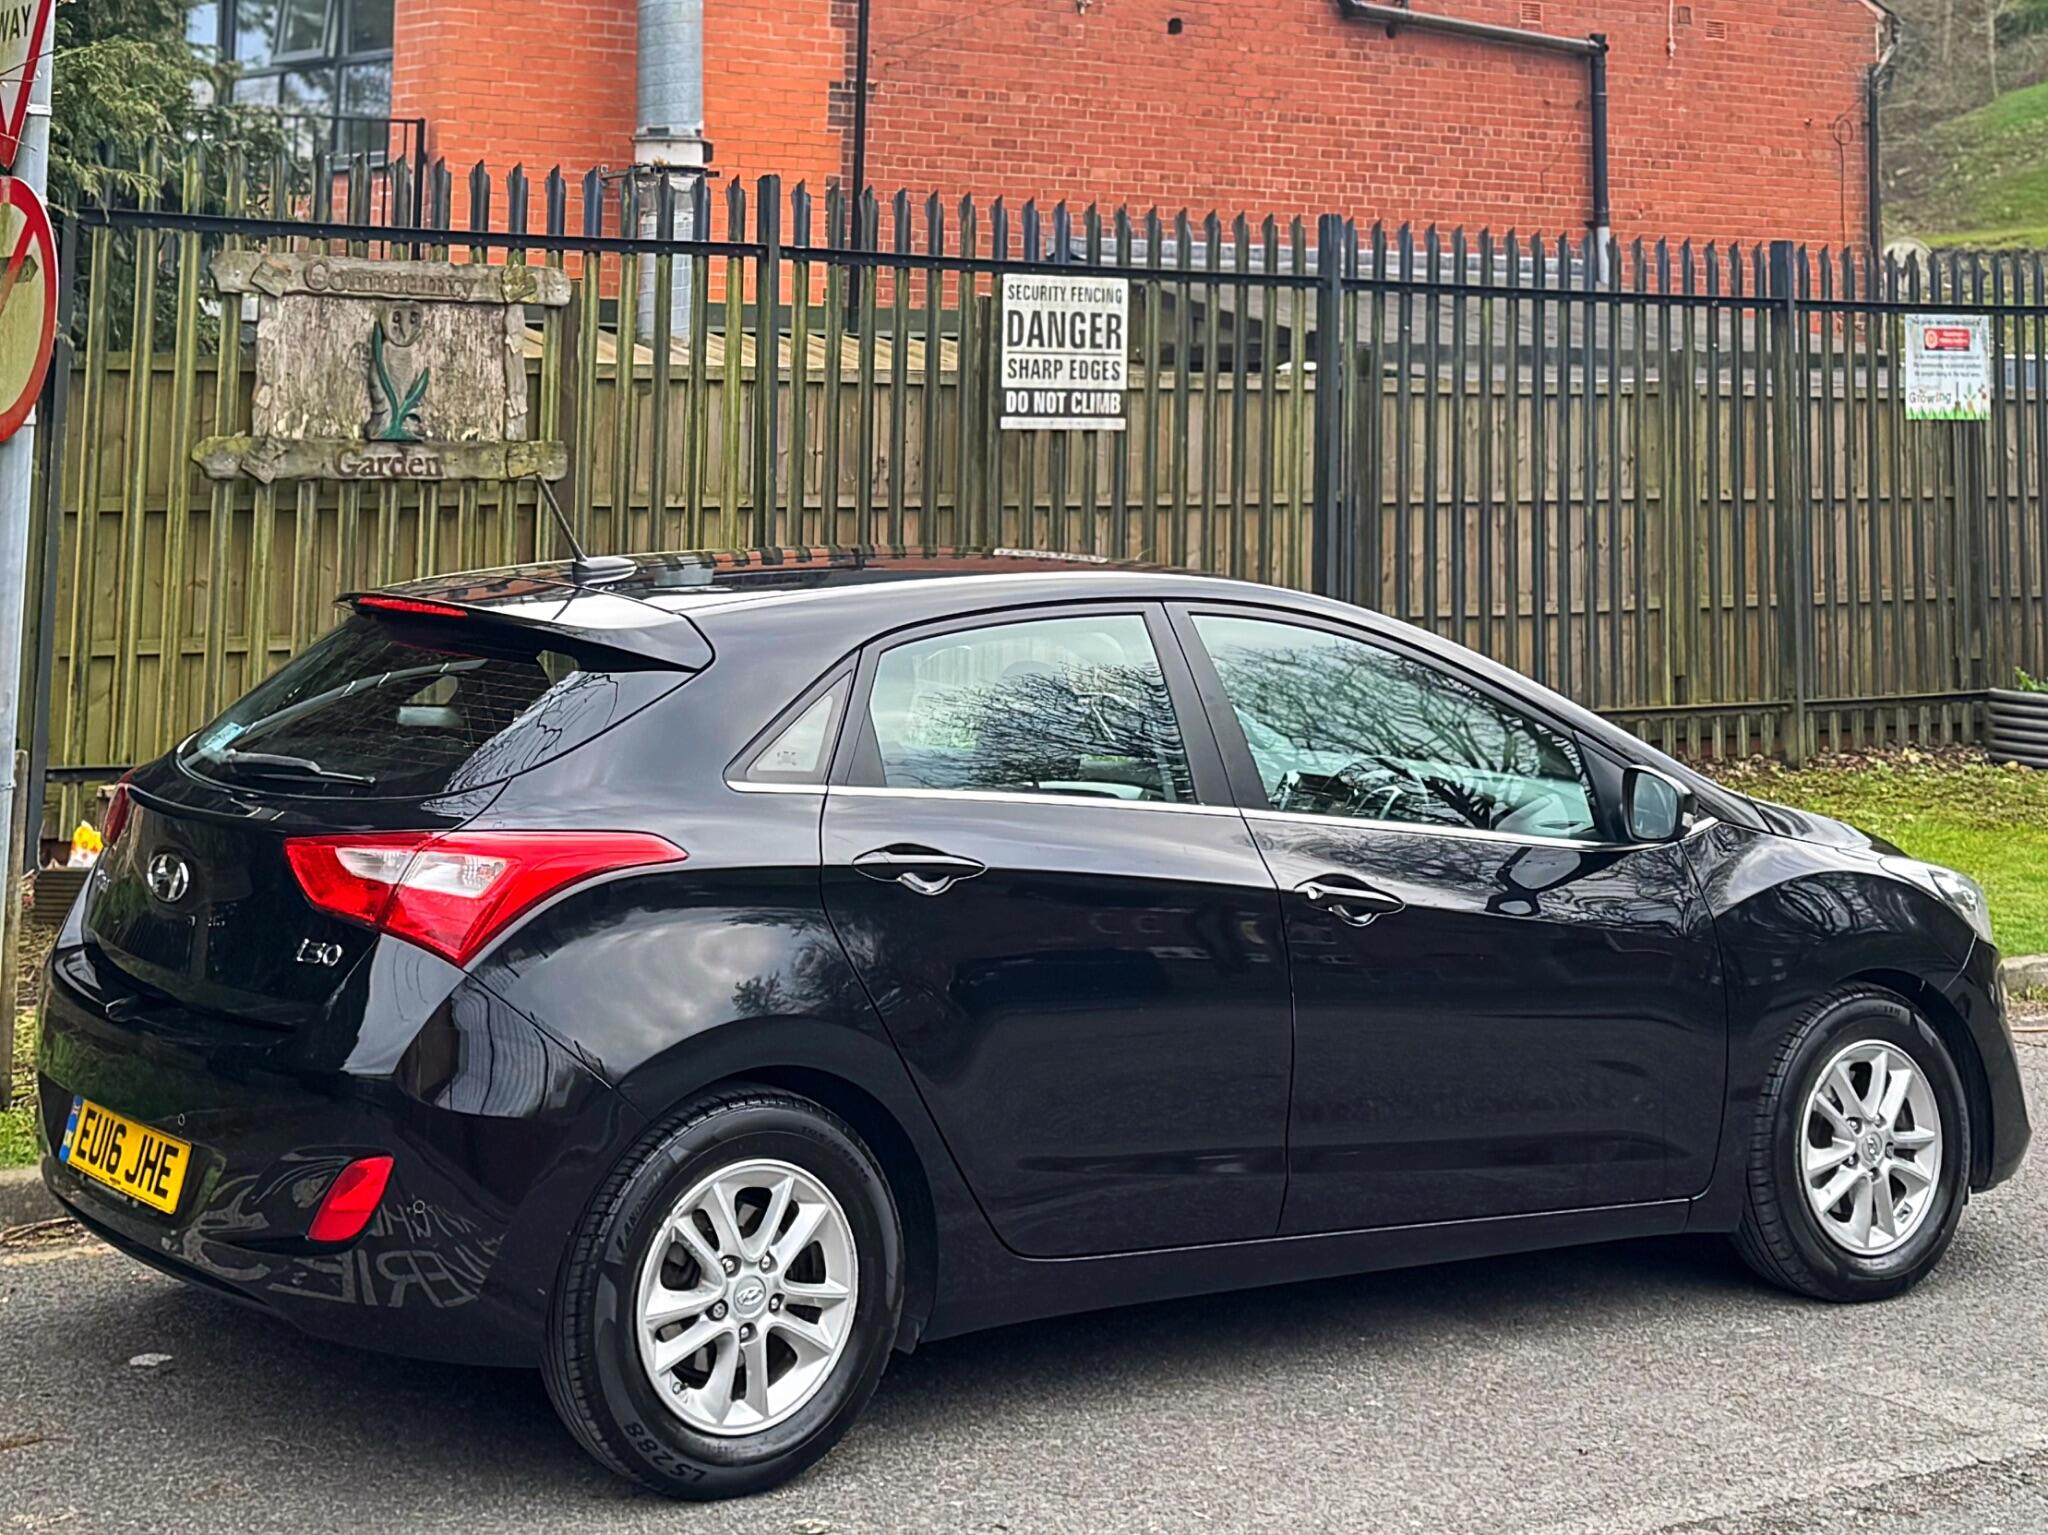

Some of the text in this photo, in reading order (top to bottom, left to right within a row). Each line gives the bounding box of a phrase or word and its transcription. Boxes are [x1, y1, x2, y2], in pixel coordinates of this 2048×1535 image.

[1008, 284, 1123, 304] SECURITY FENCING
[1007, 310, 1122, 350] DANGER
[1008, 358, 1121, 381] SHARP EDGES
[1006, 390, 1121, 414] DO NOT CLIMB
[333, 446, 444, 479] Garden
[76, 1107, 179, 1199] EU16 JHE
[625, 1422, 707, 1482] LS288
